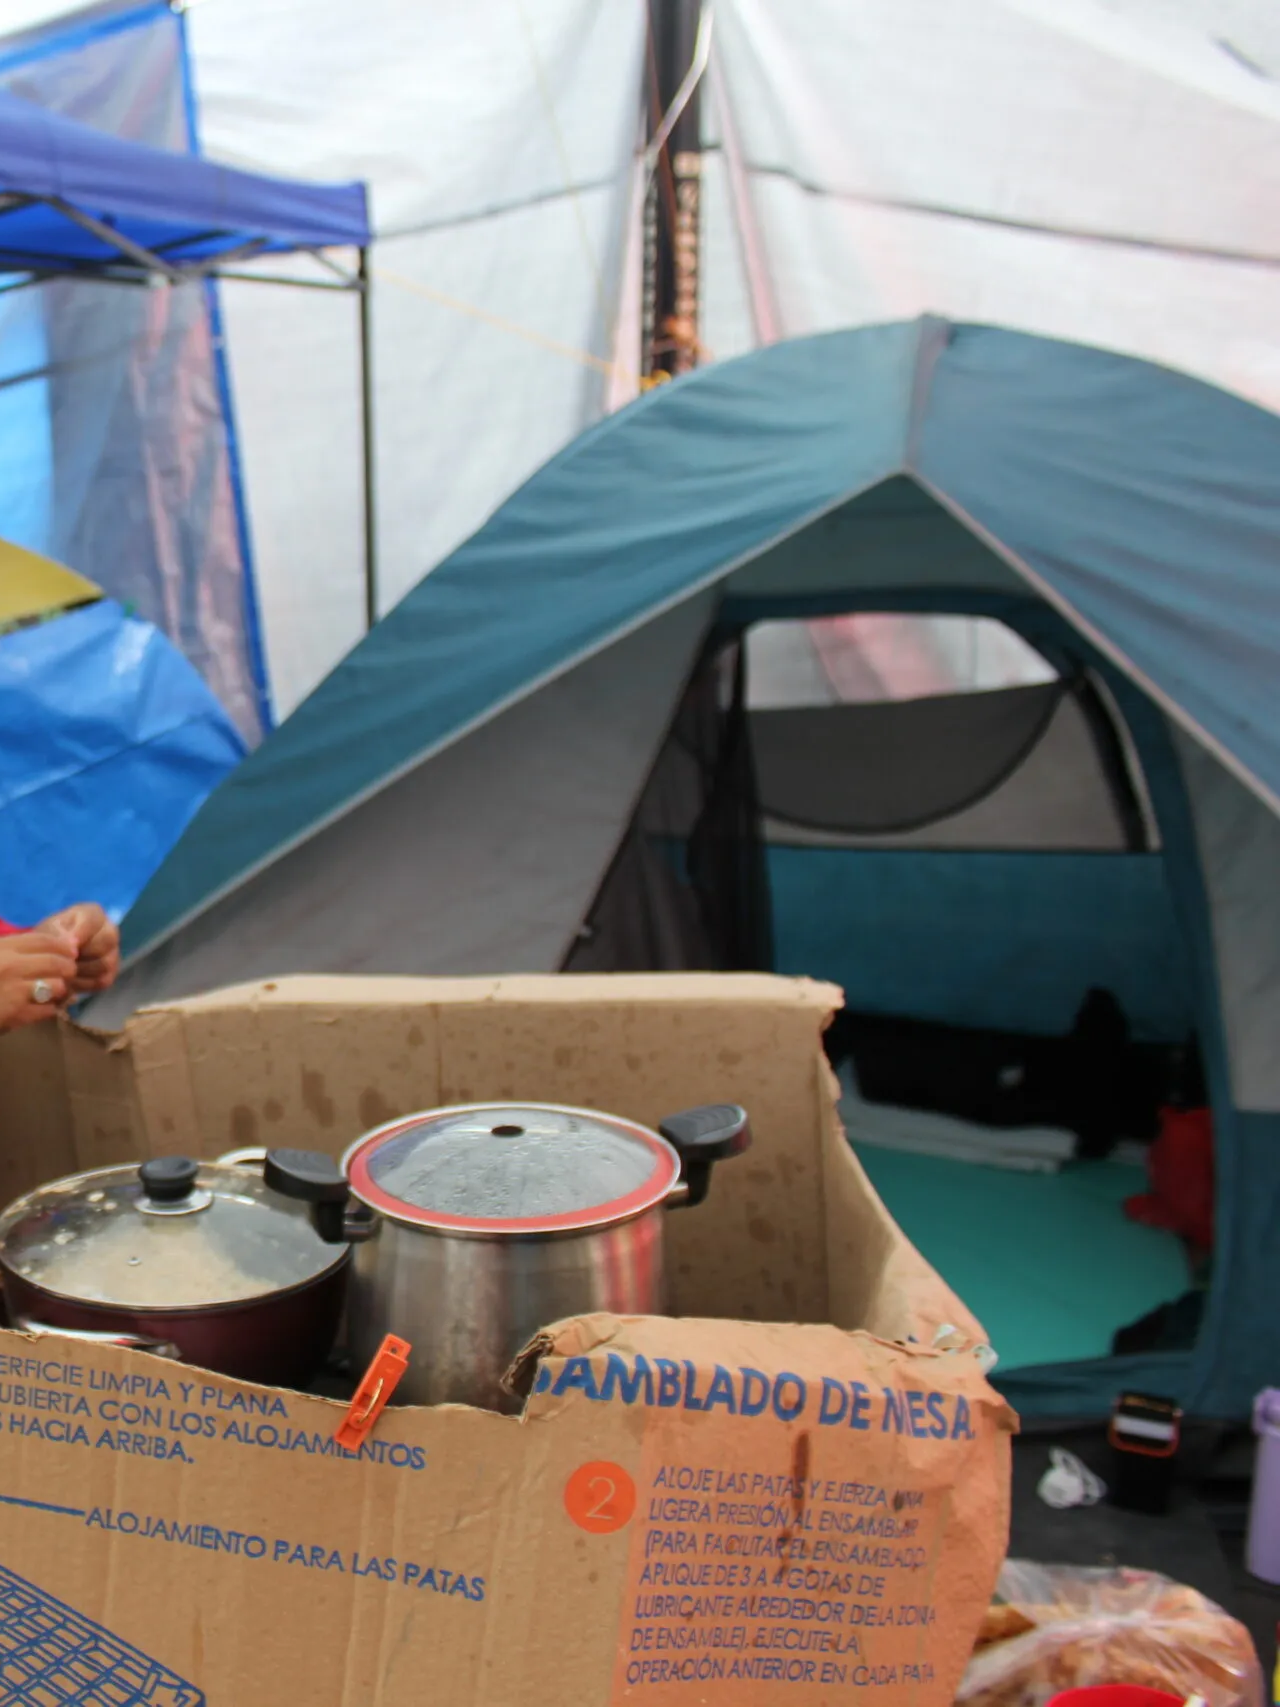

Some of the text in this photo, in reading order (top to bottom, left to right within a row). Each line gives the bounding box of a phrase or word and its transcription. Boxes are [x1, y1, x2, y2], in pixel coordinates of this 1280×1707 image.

[89, 1369, 171, 1399] LIMPIA
[178, 1381, 195, 1403] Y
[200, 1385, 288, 1419] PLANA
[819, 1377, 871, 1429] DE
[98, 1400, 163, 1428] CON
[169, 1411, 216, 1438] LOS
[9, 1414, 90, 1447] HACIA
[95, 1428, 195, 1464] ARRIBA.
[585, 1476, 616, 1520] 2
[652, 1466, 715, 1492] ALOJE
[716, 1471, 748, 1494] LAS
[751, 1474, 805, 1498] PATAS
[808, 1480, 821, 1499] Y
[824, 1481, 888, 1509] EJERZA
[648, 1498, 711, 1523] LIGERA
[716, 1500, 790, 1528] PRESIÓN
[793, 1510, 814, 1531] AL
[86, 1508, 486, 1602] ALOJAMIENTO PARA LAS PATAS
[646, 1529, 698, 1559] (PARA
[703, 1533, 788, 1560] FACILITAR
[788, 1538, 806, 1560] EL
[639, 1562, 886, 1598] APLIQUE DE 3 A 4 GOTAS DE
[635, 1594, 736, 1619] LUBRICANTE
[736, 1595, 846, 1624] ALREDEDOR
[849, 1604, 878, 1627] DE
[630, 1627, 654, 1651] DE
[753, 1627, 834, 1653] EJECUTE
[835, 1633, 860, 1656] LA
[626, 1652, 727, 1685] OPERACIÓN
[727, 1656, 818, 1683] ANTERIOR
[820, 1661, 849, 1684] EN
[852, 1664, 899, 1688] CADA
